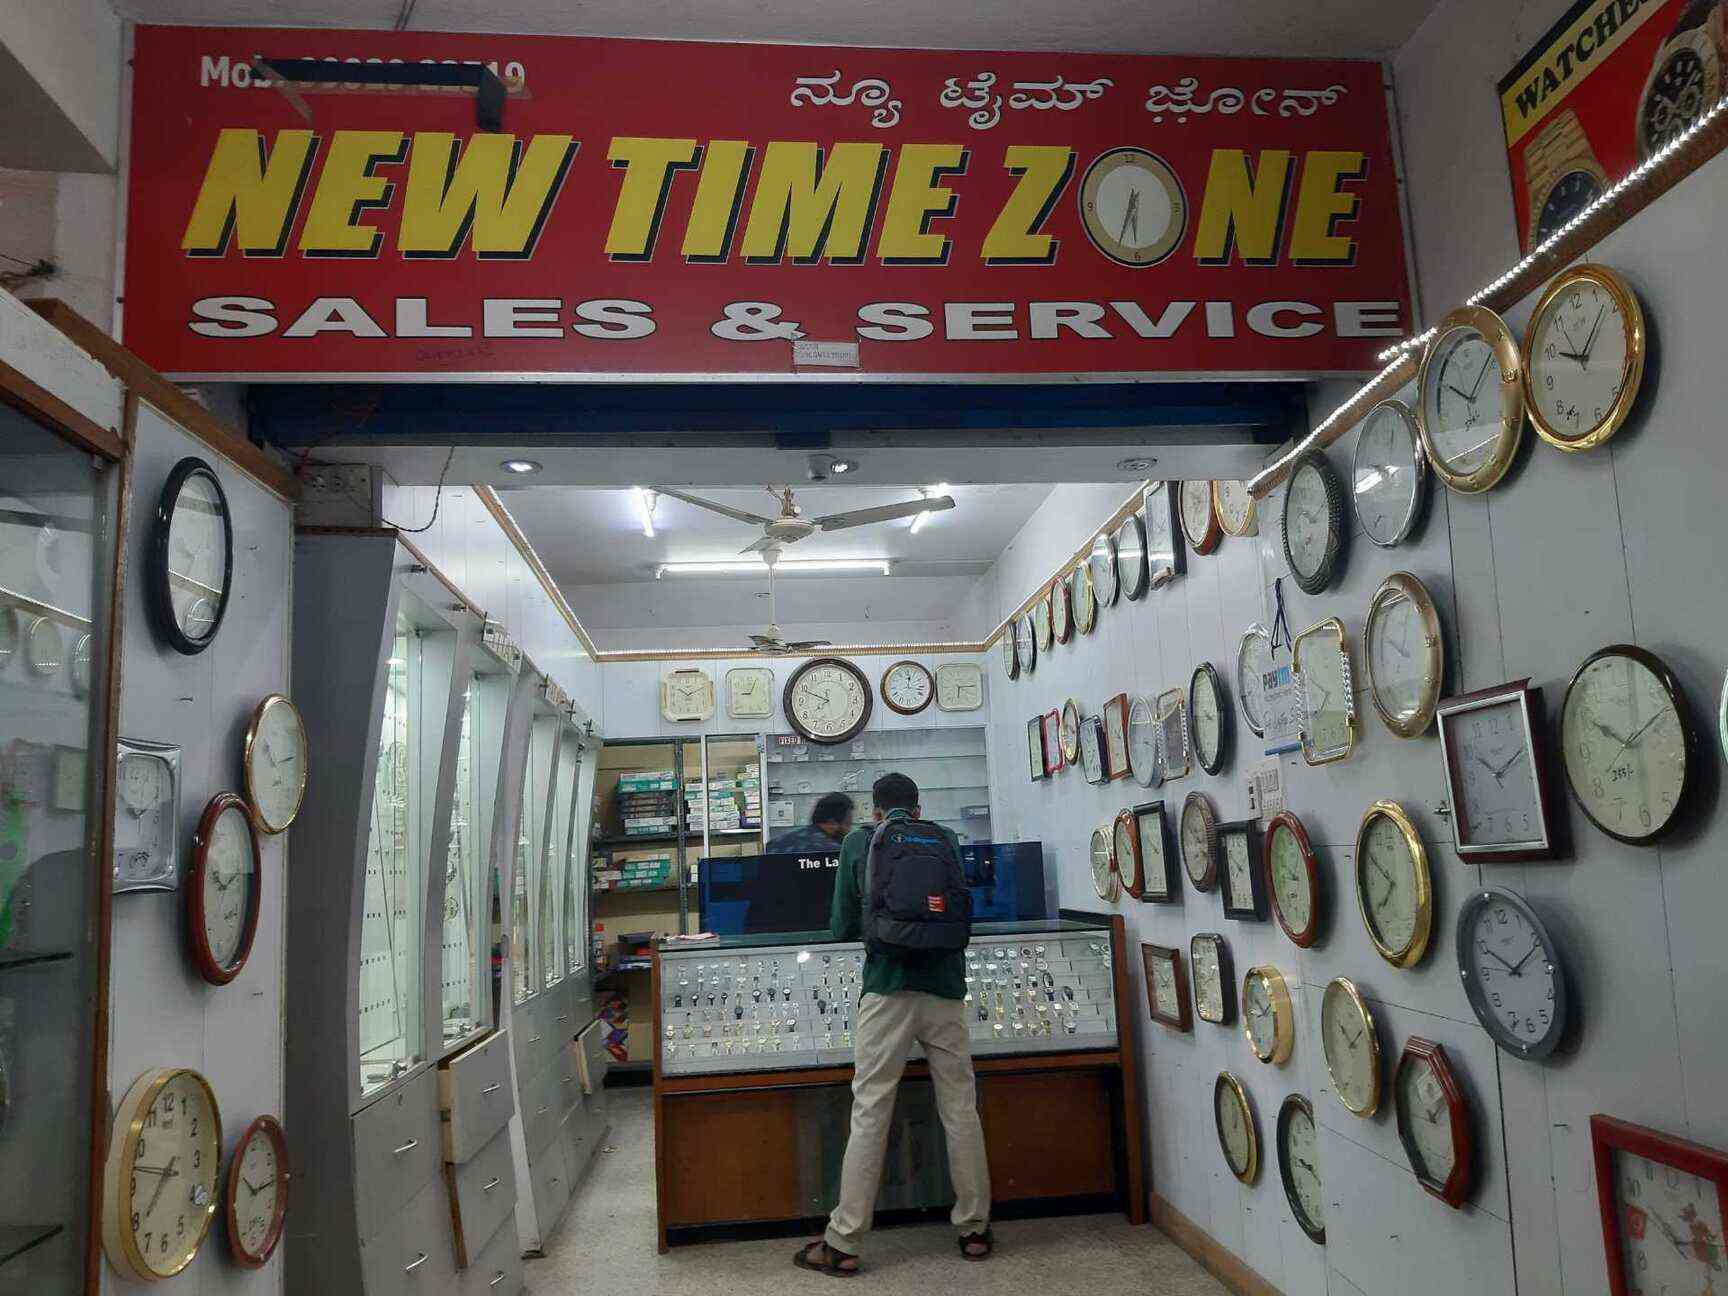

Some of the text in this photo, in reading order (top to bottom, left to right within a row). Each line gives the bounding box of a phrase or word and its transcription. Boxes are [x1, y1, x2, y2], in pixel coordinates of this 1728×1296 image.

[1515, 0, 1647, 119] WATCHE
[939, 71, 1114, 130] ಟೈಮ್
[181, 128, 581, 260] NEW
[604, 136, 969, 266] TIME
[187, 296, 1403, 341] SALES & SERVICE
[798, 858, 821, 869] The
